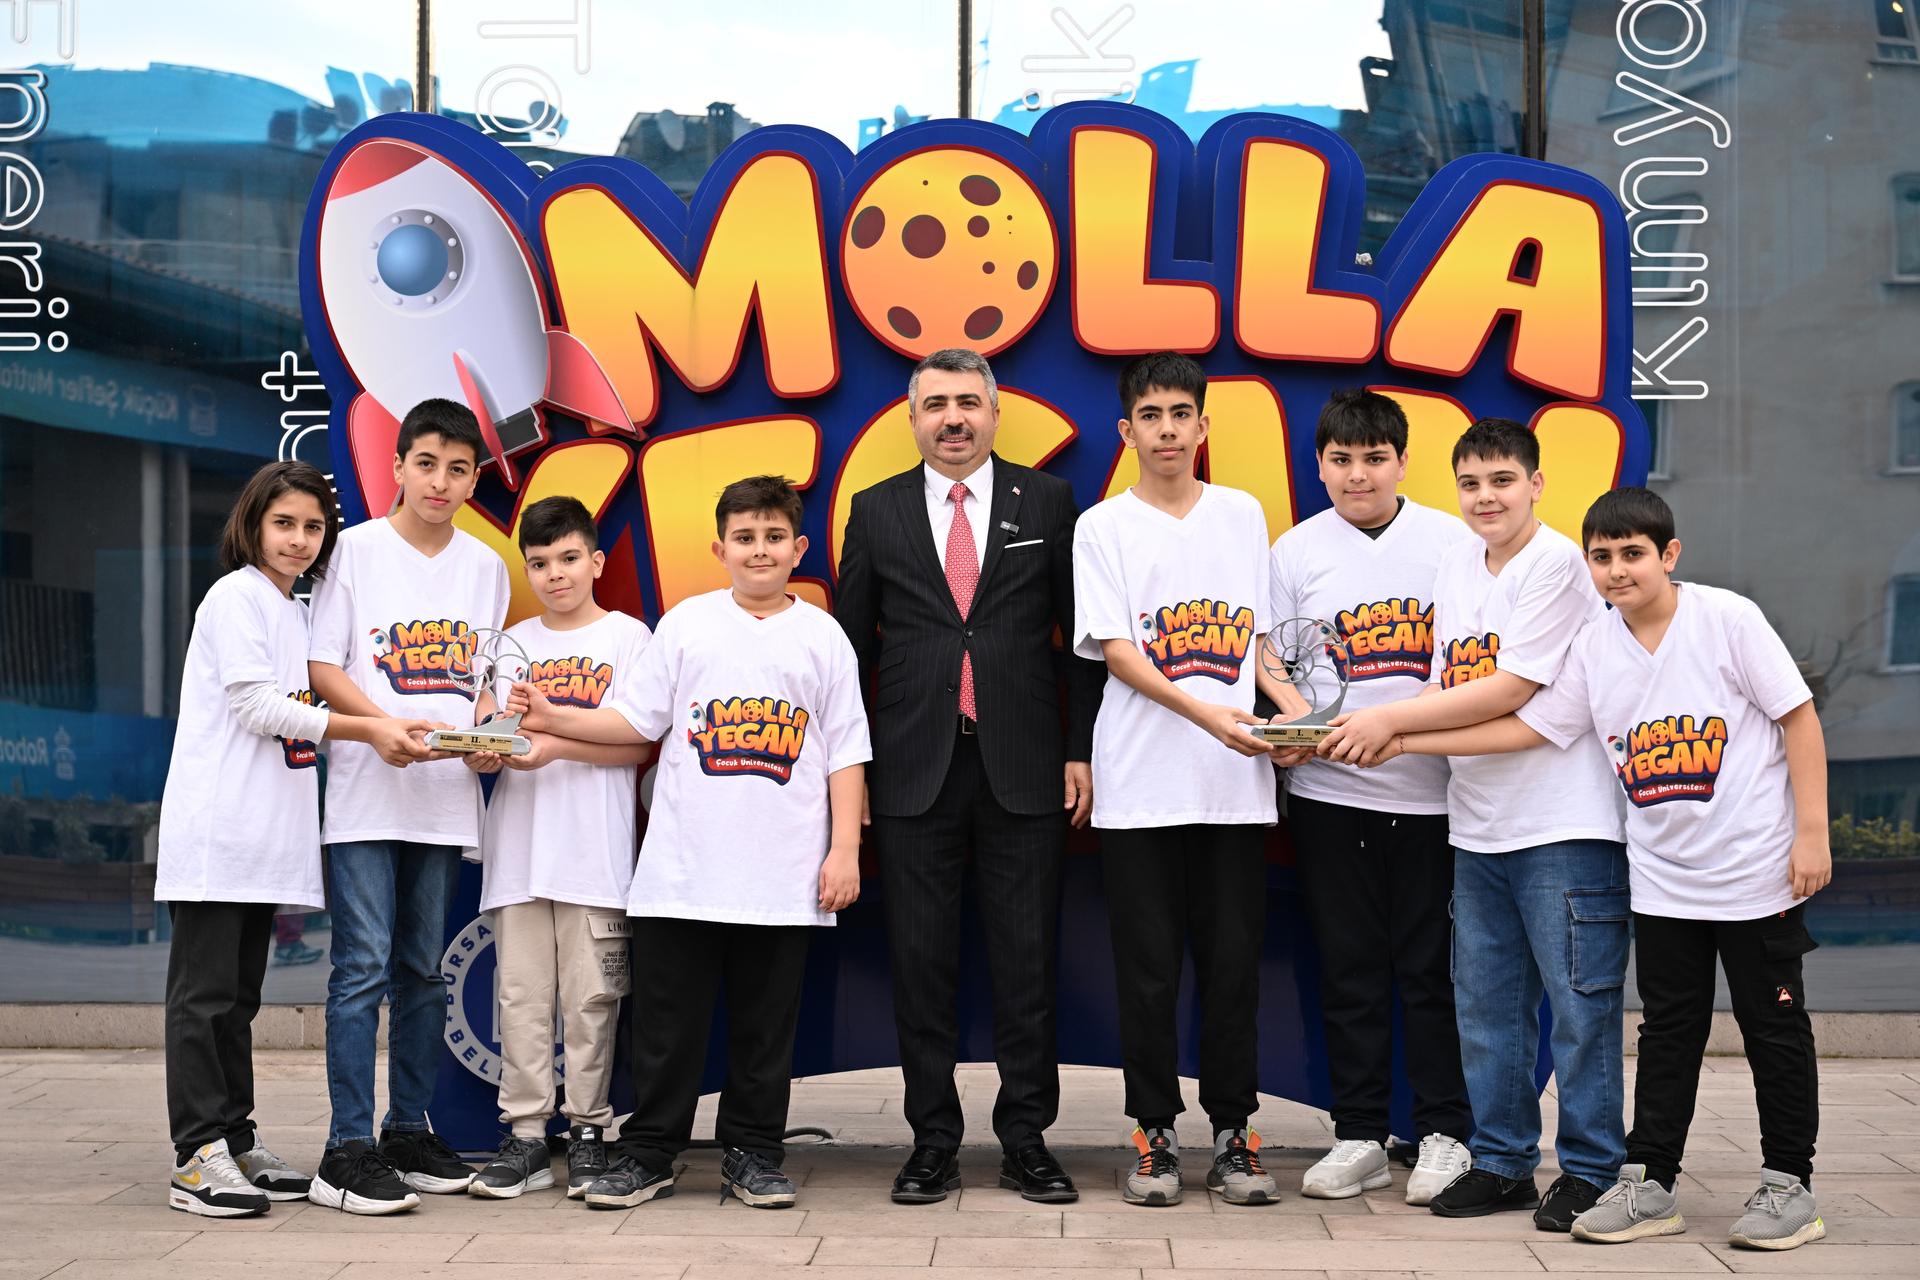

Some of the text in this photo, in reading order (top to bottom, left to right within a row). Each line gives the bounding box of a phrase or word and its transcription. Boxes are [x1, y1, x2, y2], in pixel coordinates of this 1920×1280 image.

[540, 124, 1608, 432] MOLLA
[1161, 599, 1253, 633] MOLLA
[1149, 624, 1250, 660] YEGAN
[532, 657, 613, 683] MOLLA
[1353, 660, 1424, 673] Çocuk Üniversitesi
[533, 675, 607, 705] EGAN
[712, 697, 809, 731] MOLLA
[694, 723, 804, 760] YEGAN
[1630, 716, 1727, 755] MOLLA
[716, 758, 784, 774] Çocuk Üniversitesi
[1622, 739, 1723, 785] YEGAN
[1638, 788, 1657, 798] Çocuk
